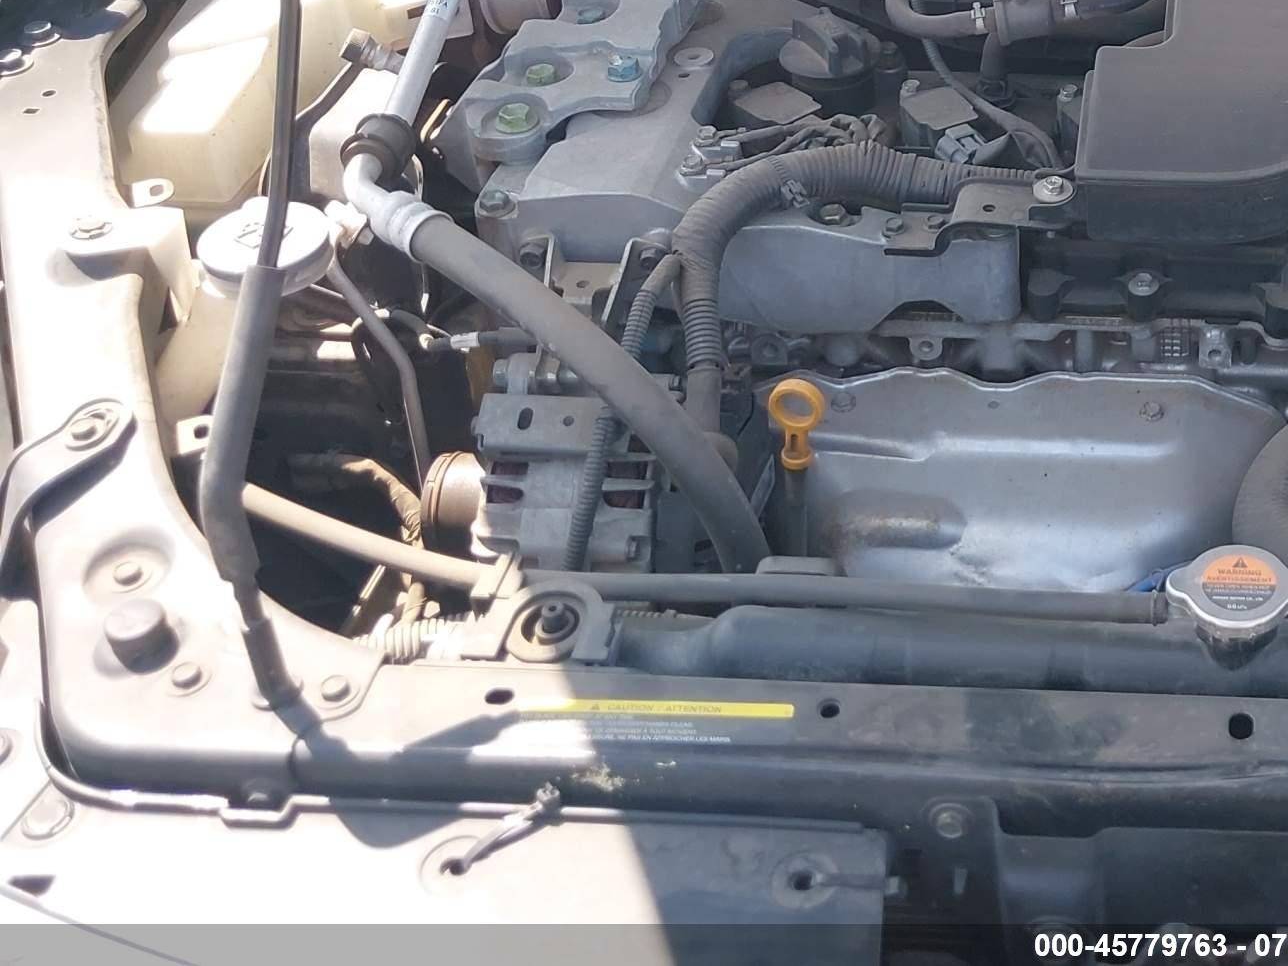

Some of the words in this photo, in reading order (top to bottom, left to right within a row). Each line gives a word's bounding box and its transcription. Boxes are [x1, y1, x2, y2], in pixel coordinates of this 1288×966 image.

[1217, 568, 1262, 576] WARNING
[606, 704, 654, 713] CAUTION
[665, 705, 722, 714] ATTENTION
